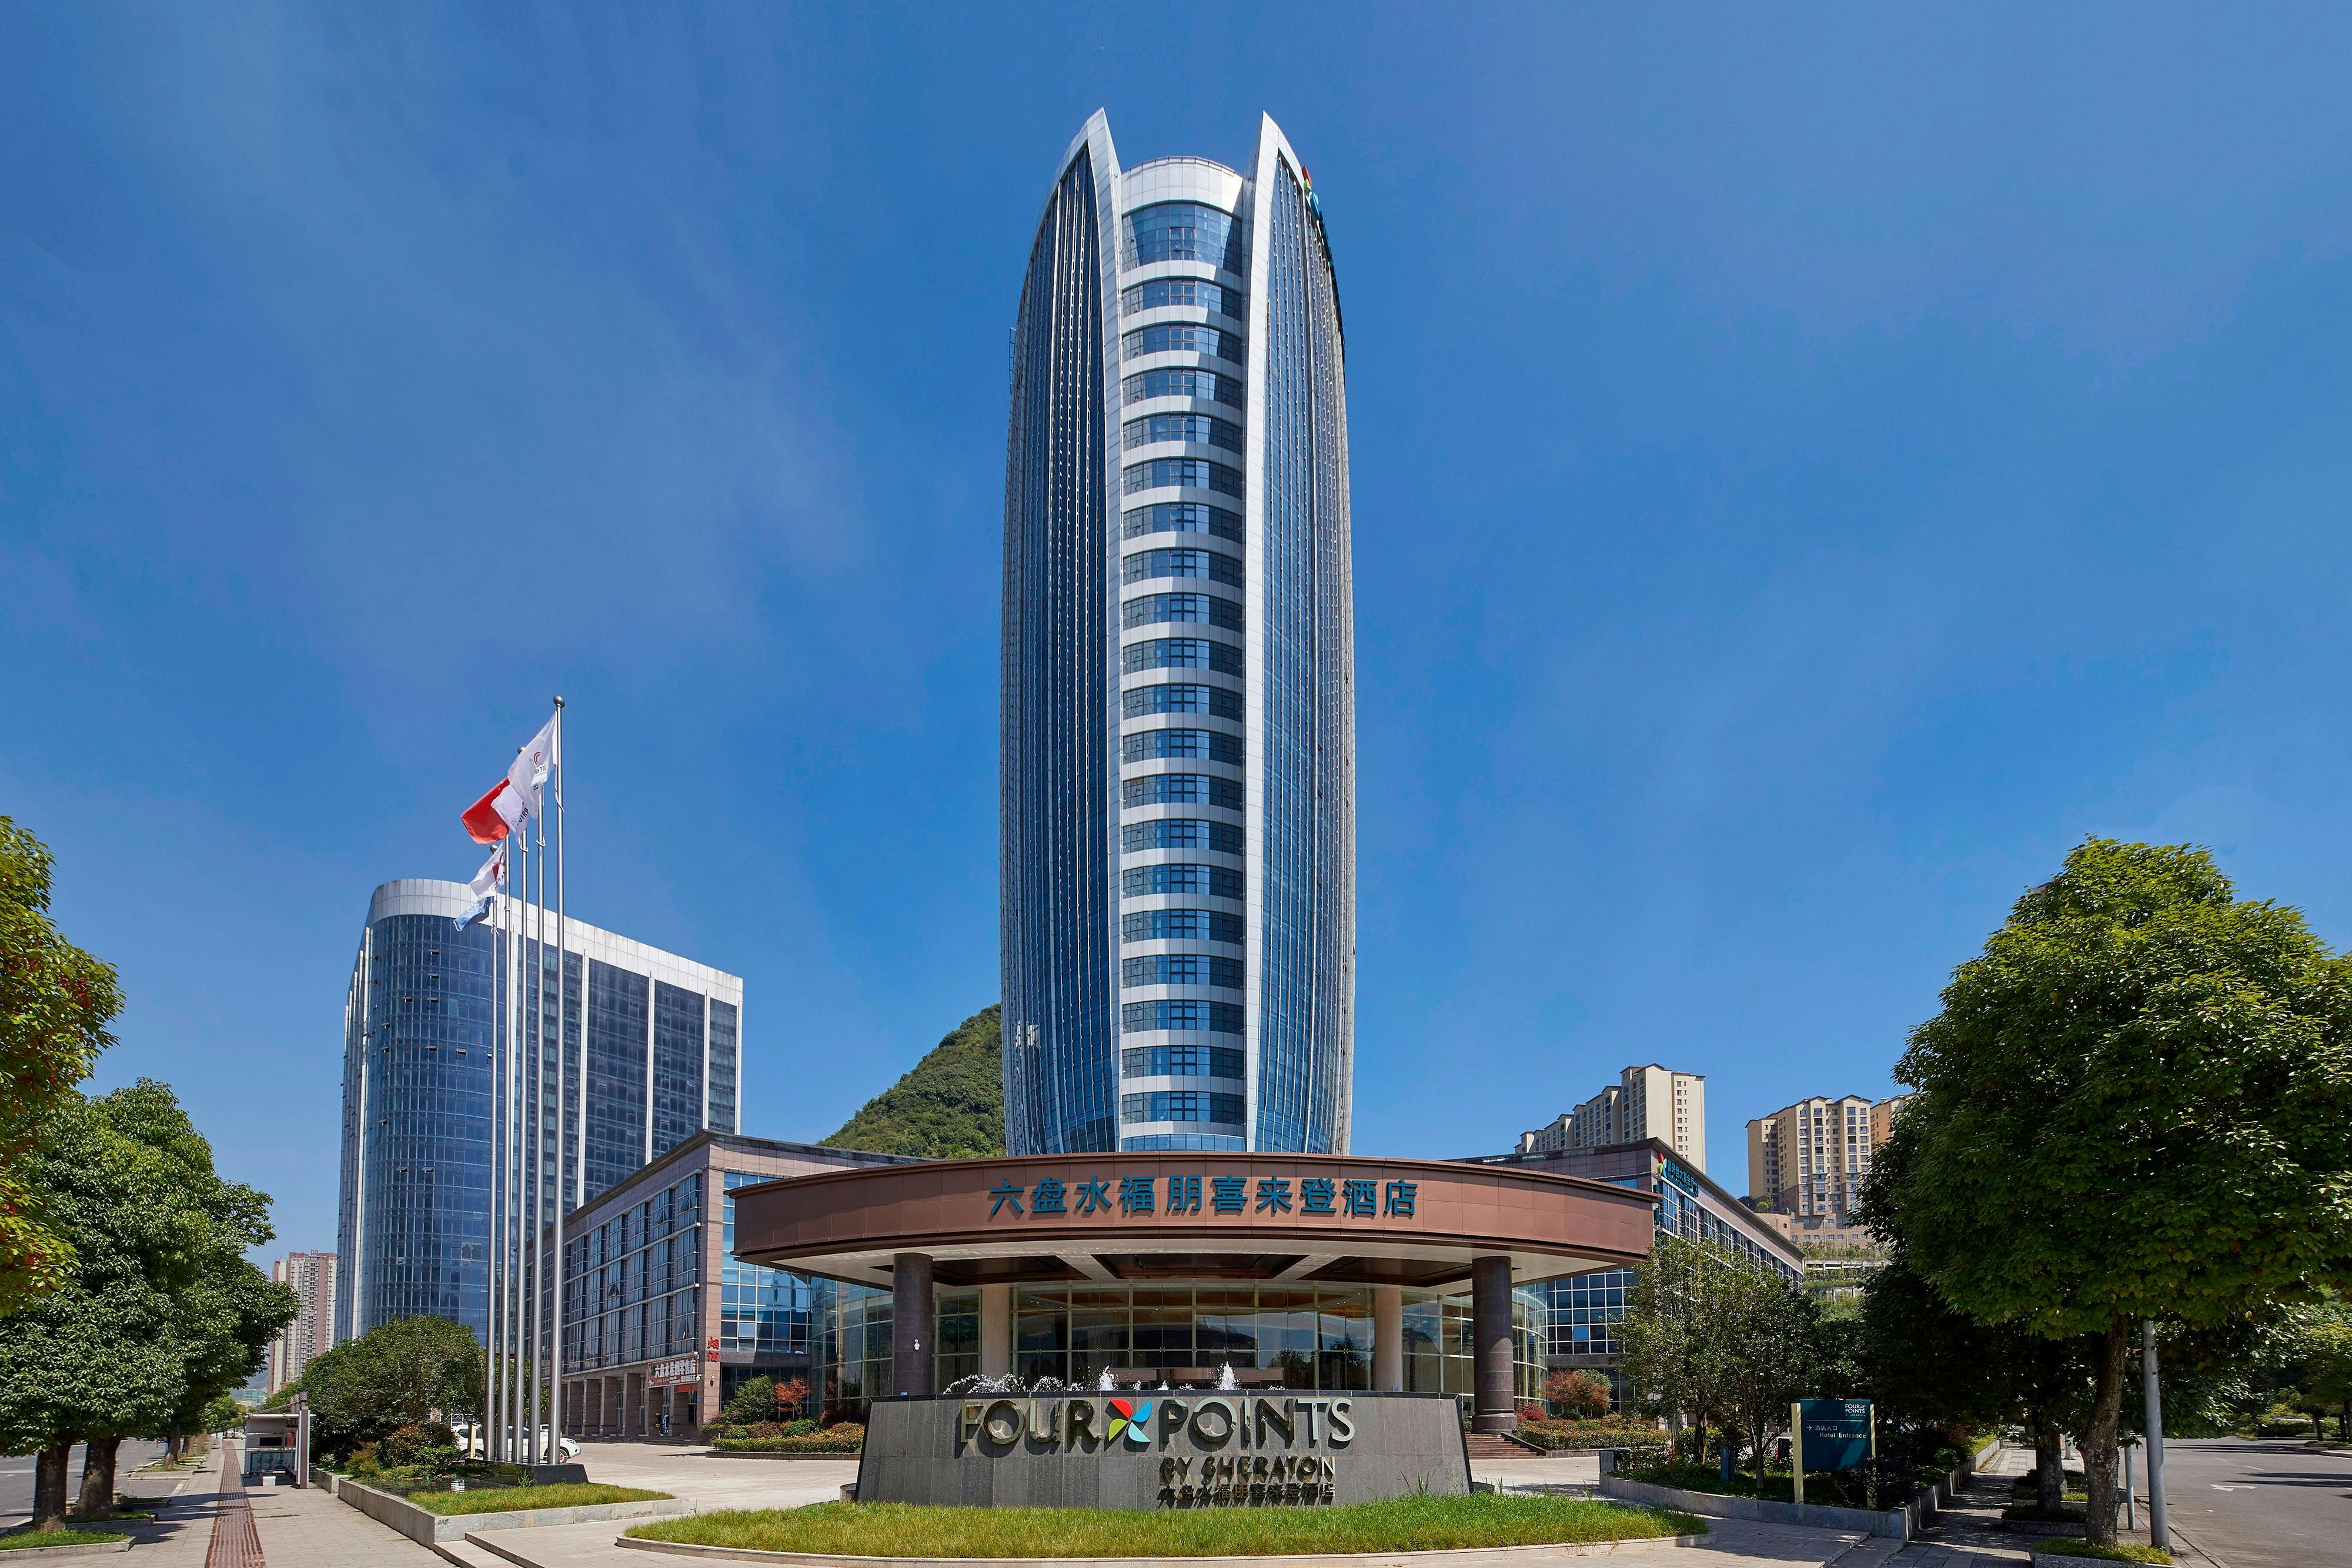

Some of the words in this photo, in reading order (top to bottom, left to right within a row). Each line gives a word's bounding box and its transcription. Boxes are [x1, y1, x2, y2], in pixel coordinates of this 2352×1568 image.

[990, 1175, 1418, 1215] 六盘水福朋喜来登酒店
[961, 1399, 1101, 1445] FOUR
[1162, 1397, 1355, 1443] POINTS
[1164, 1456, 1194, 1475] BY
[1204, 1456, 1336, 1475] SHERATON
